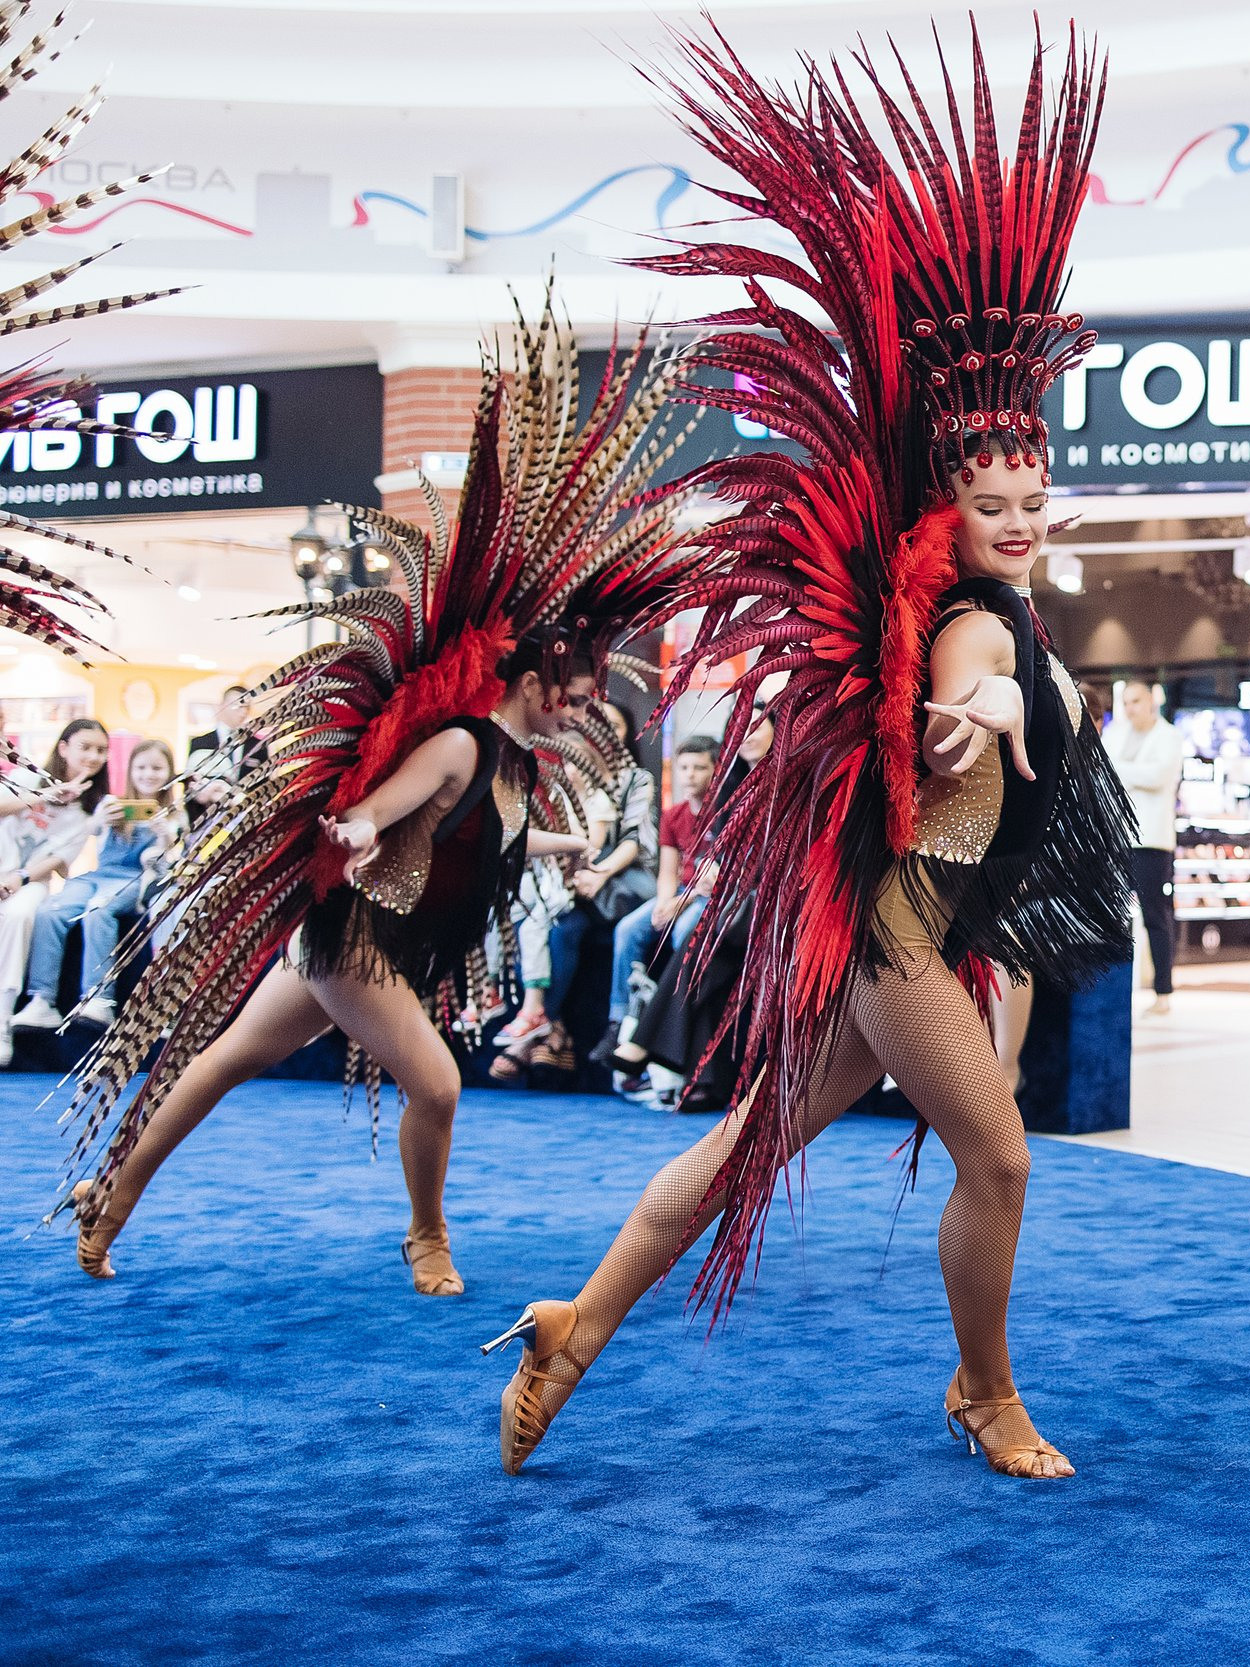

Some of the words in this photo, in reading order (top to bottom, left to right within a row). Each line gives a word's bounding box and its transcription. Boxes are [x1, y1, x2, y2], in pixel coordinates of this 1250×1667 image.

[95, 384, 258, 468] ГОШ
[1067, 444, 1089, 467] и
[105, 480, 122, 500] и
[128, 473, 263, 499] косметика
